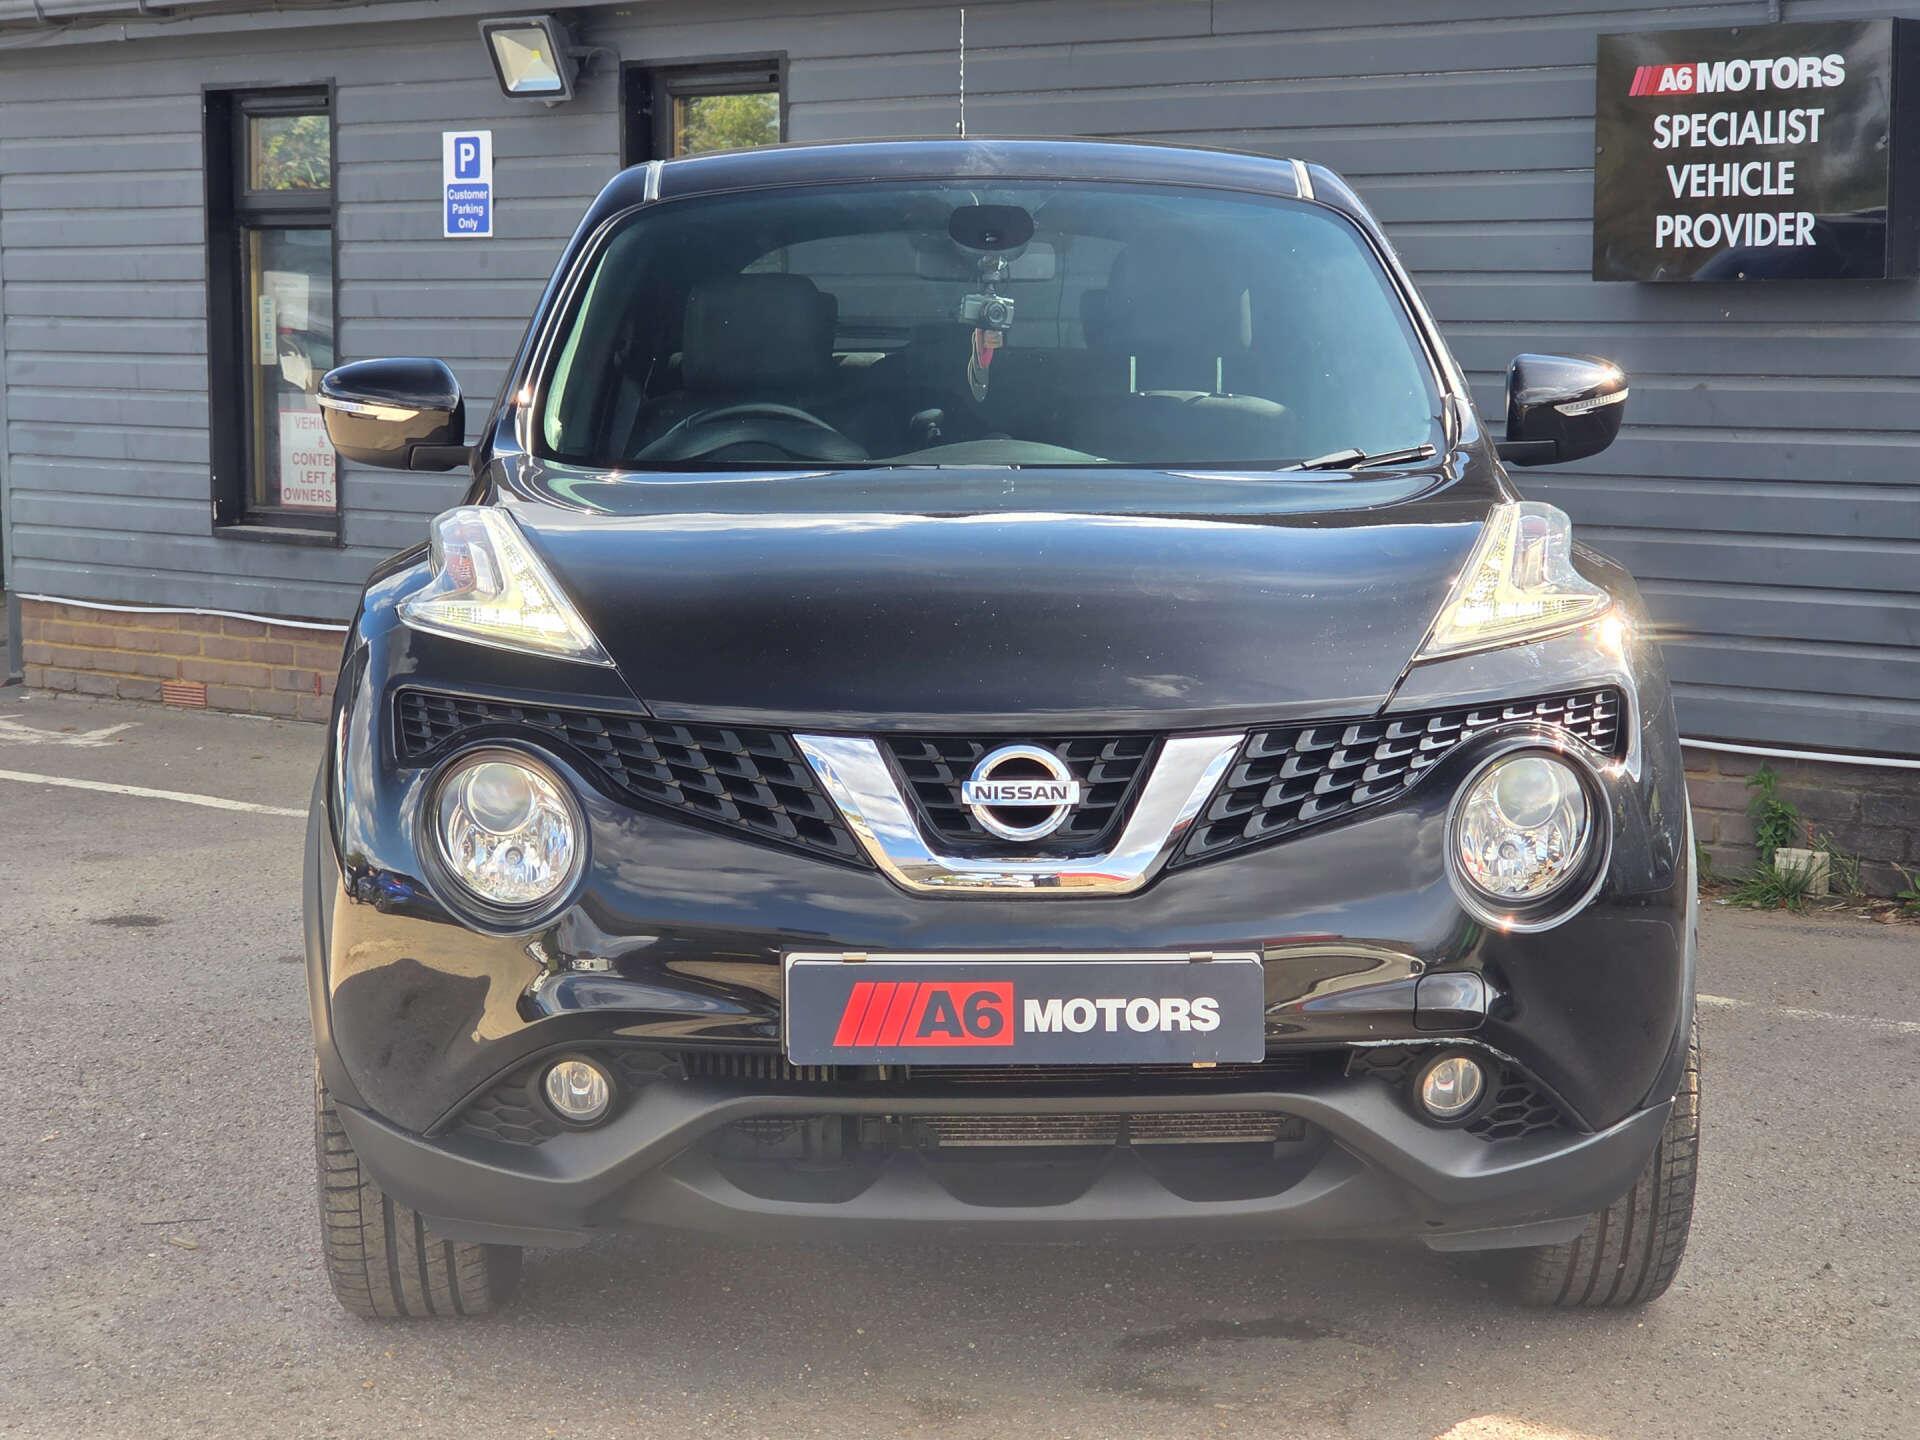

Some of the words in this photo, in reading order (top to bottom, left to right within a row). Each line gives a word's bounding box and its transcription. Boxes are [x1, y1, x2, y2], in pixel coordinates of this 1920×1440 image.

[1658, 67, 1692, 92] A6
[1696, 54, 1846, 94] MOTORS
[1653, 108, 1825, 149] SPECIALIST
[460, 143, 475, 172] P
[1666, 161, 1795, 199] VEHICLE
[448, 189, 488, 200] Customer
[452, 203, 484, 217] Parking
[458, 218, 478, 231] Only
[1655, 211, 1817, 249] PROVIDER
[300, 470, 328, 485] LEFT
[284, 488, 332, 502] OWNERS
[975, 785, 1067, 801] NISSAN
[915, 990, 1004, 1039] A6
[1023, 997, 1221, 1033] MOTORS
